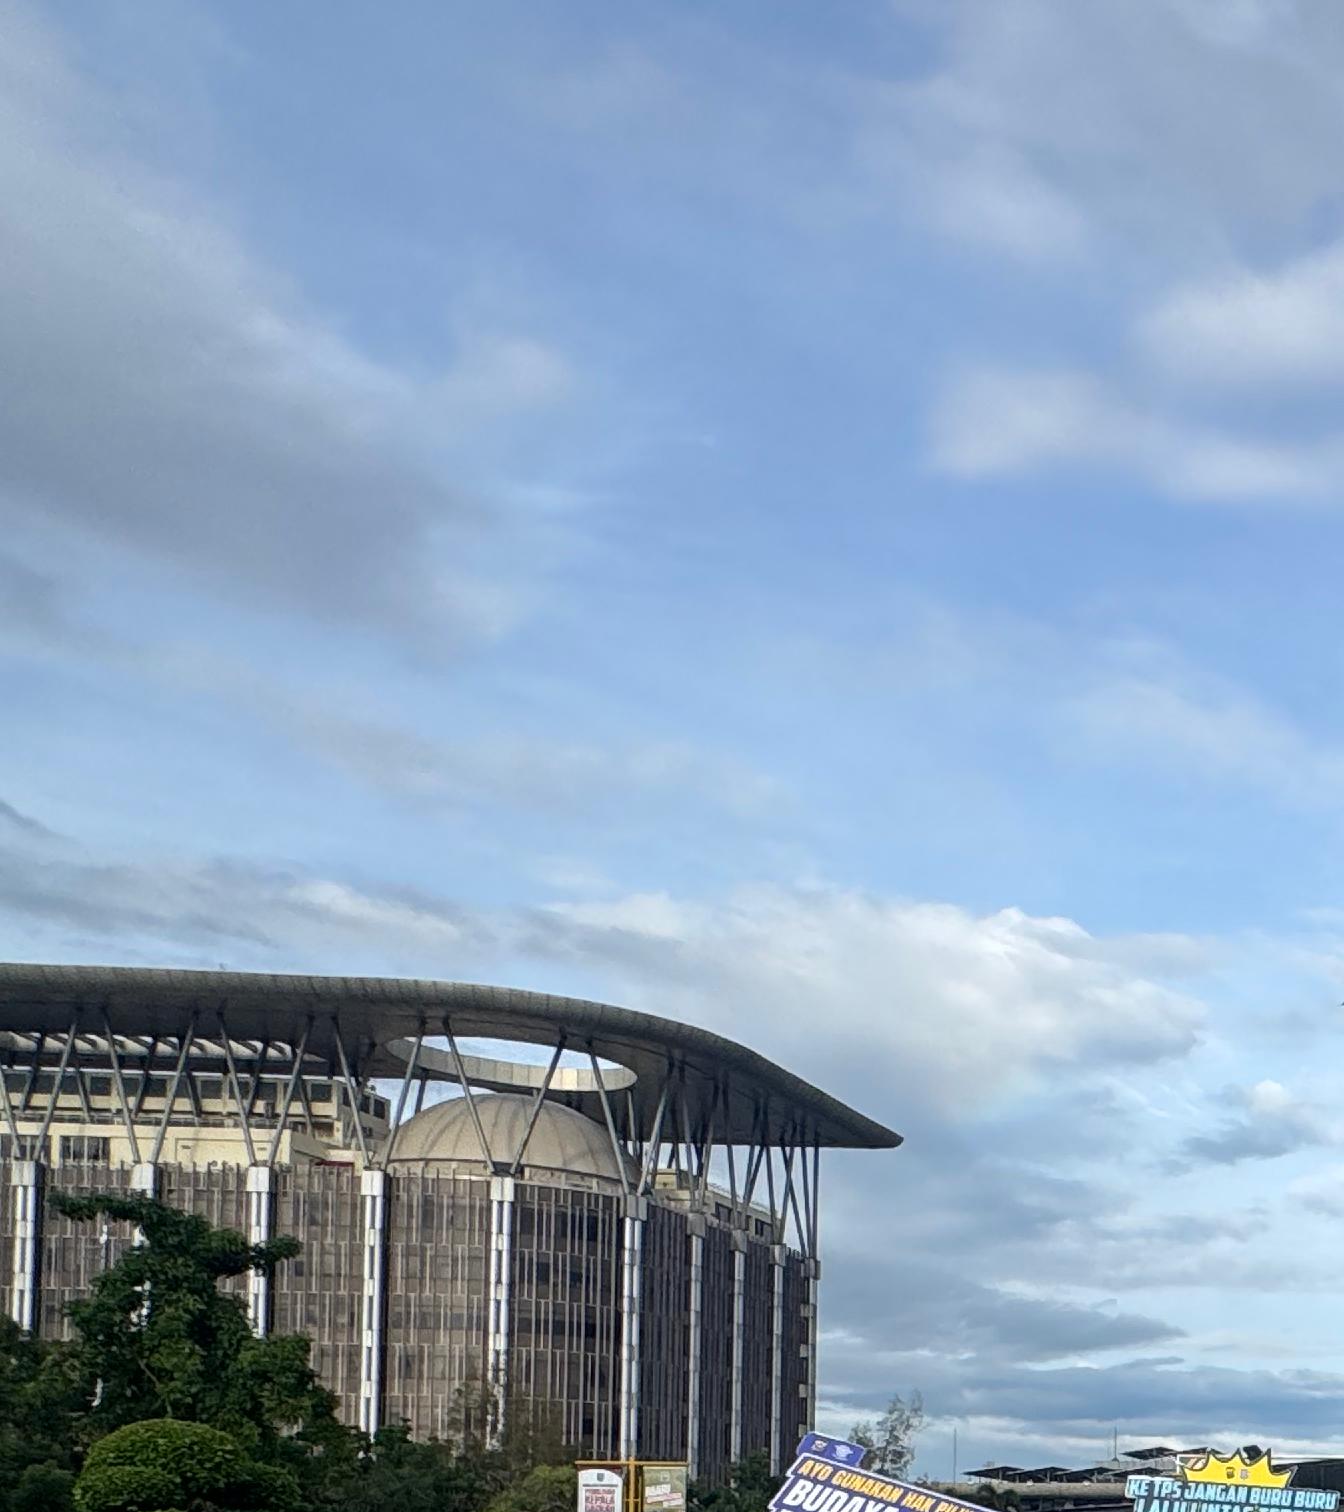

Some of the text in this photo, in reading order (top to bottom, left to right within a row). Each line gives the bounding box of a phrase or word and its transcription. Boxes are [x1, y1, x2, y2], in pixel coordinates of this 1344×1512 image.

[798, 1459, 834, 1478] AYO
[831, 1469, 904, 1504] GUNAKAN
[1129, 1478, 1339, 1510] KE TPS JANGAN BURU BURU
